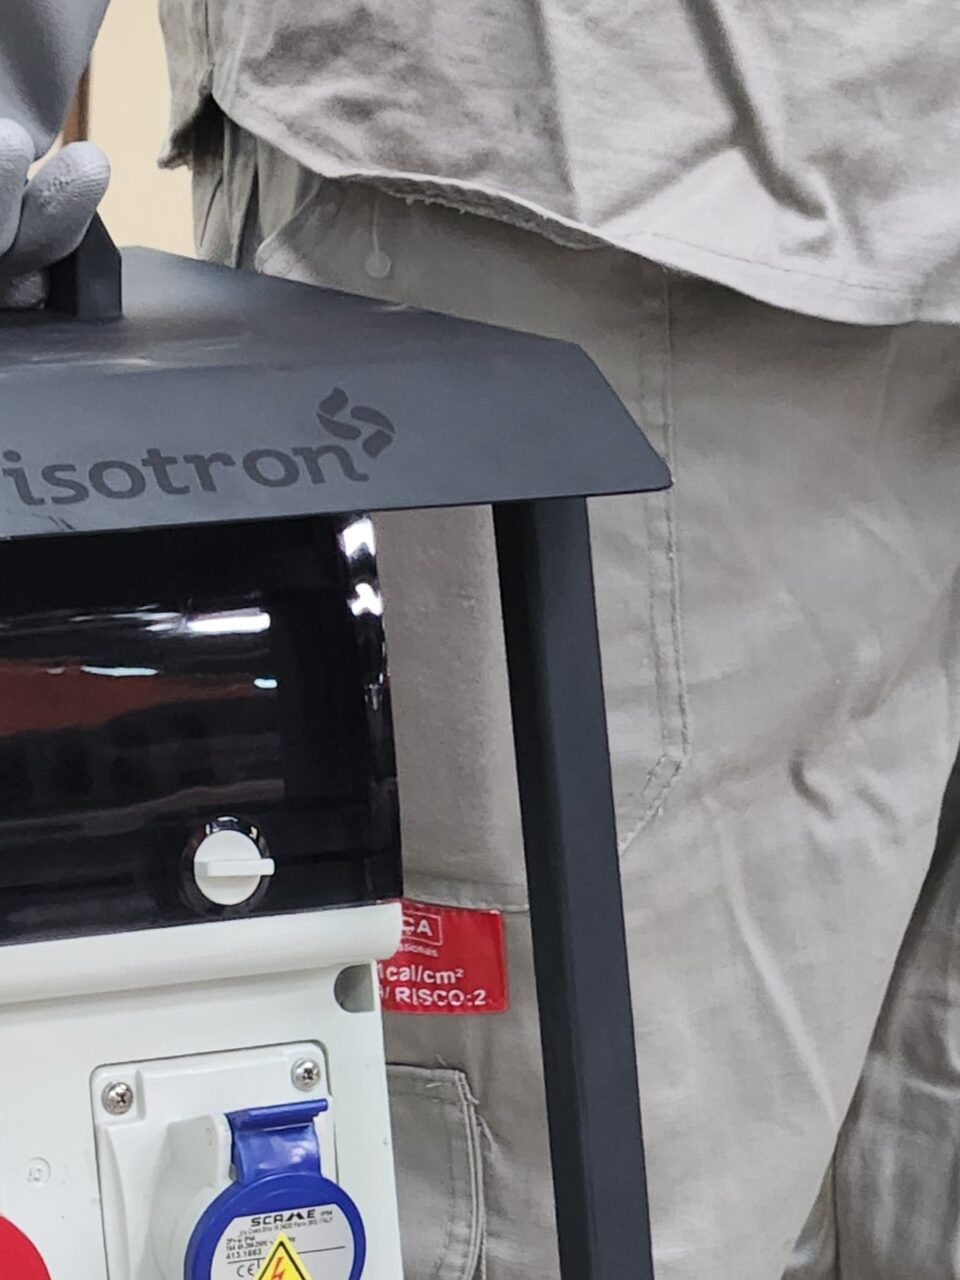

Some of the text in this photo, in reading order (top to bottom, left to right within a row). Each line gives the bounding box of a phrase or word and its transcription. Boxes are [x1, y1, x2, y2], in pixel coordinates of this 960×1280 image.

[2, 444, 369, 506] isotron
[395, 986, 486, 1006] RISCO:2
[251, 1209, 316, 1227] SCAME
